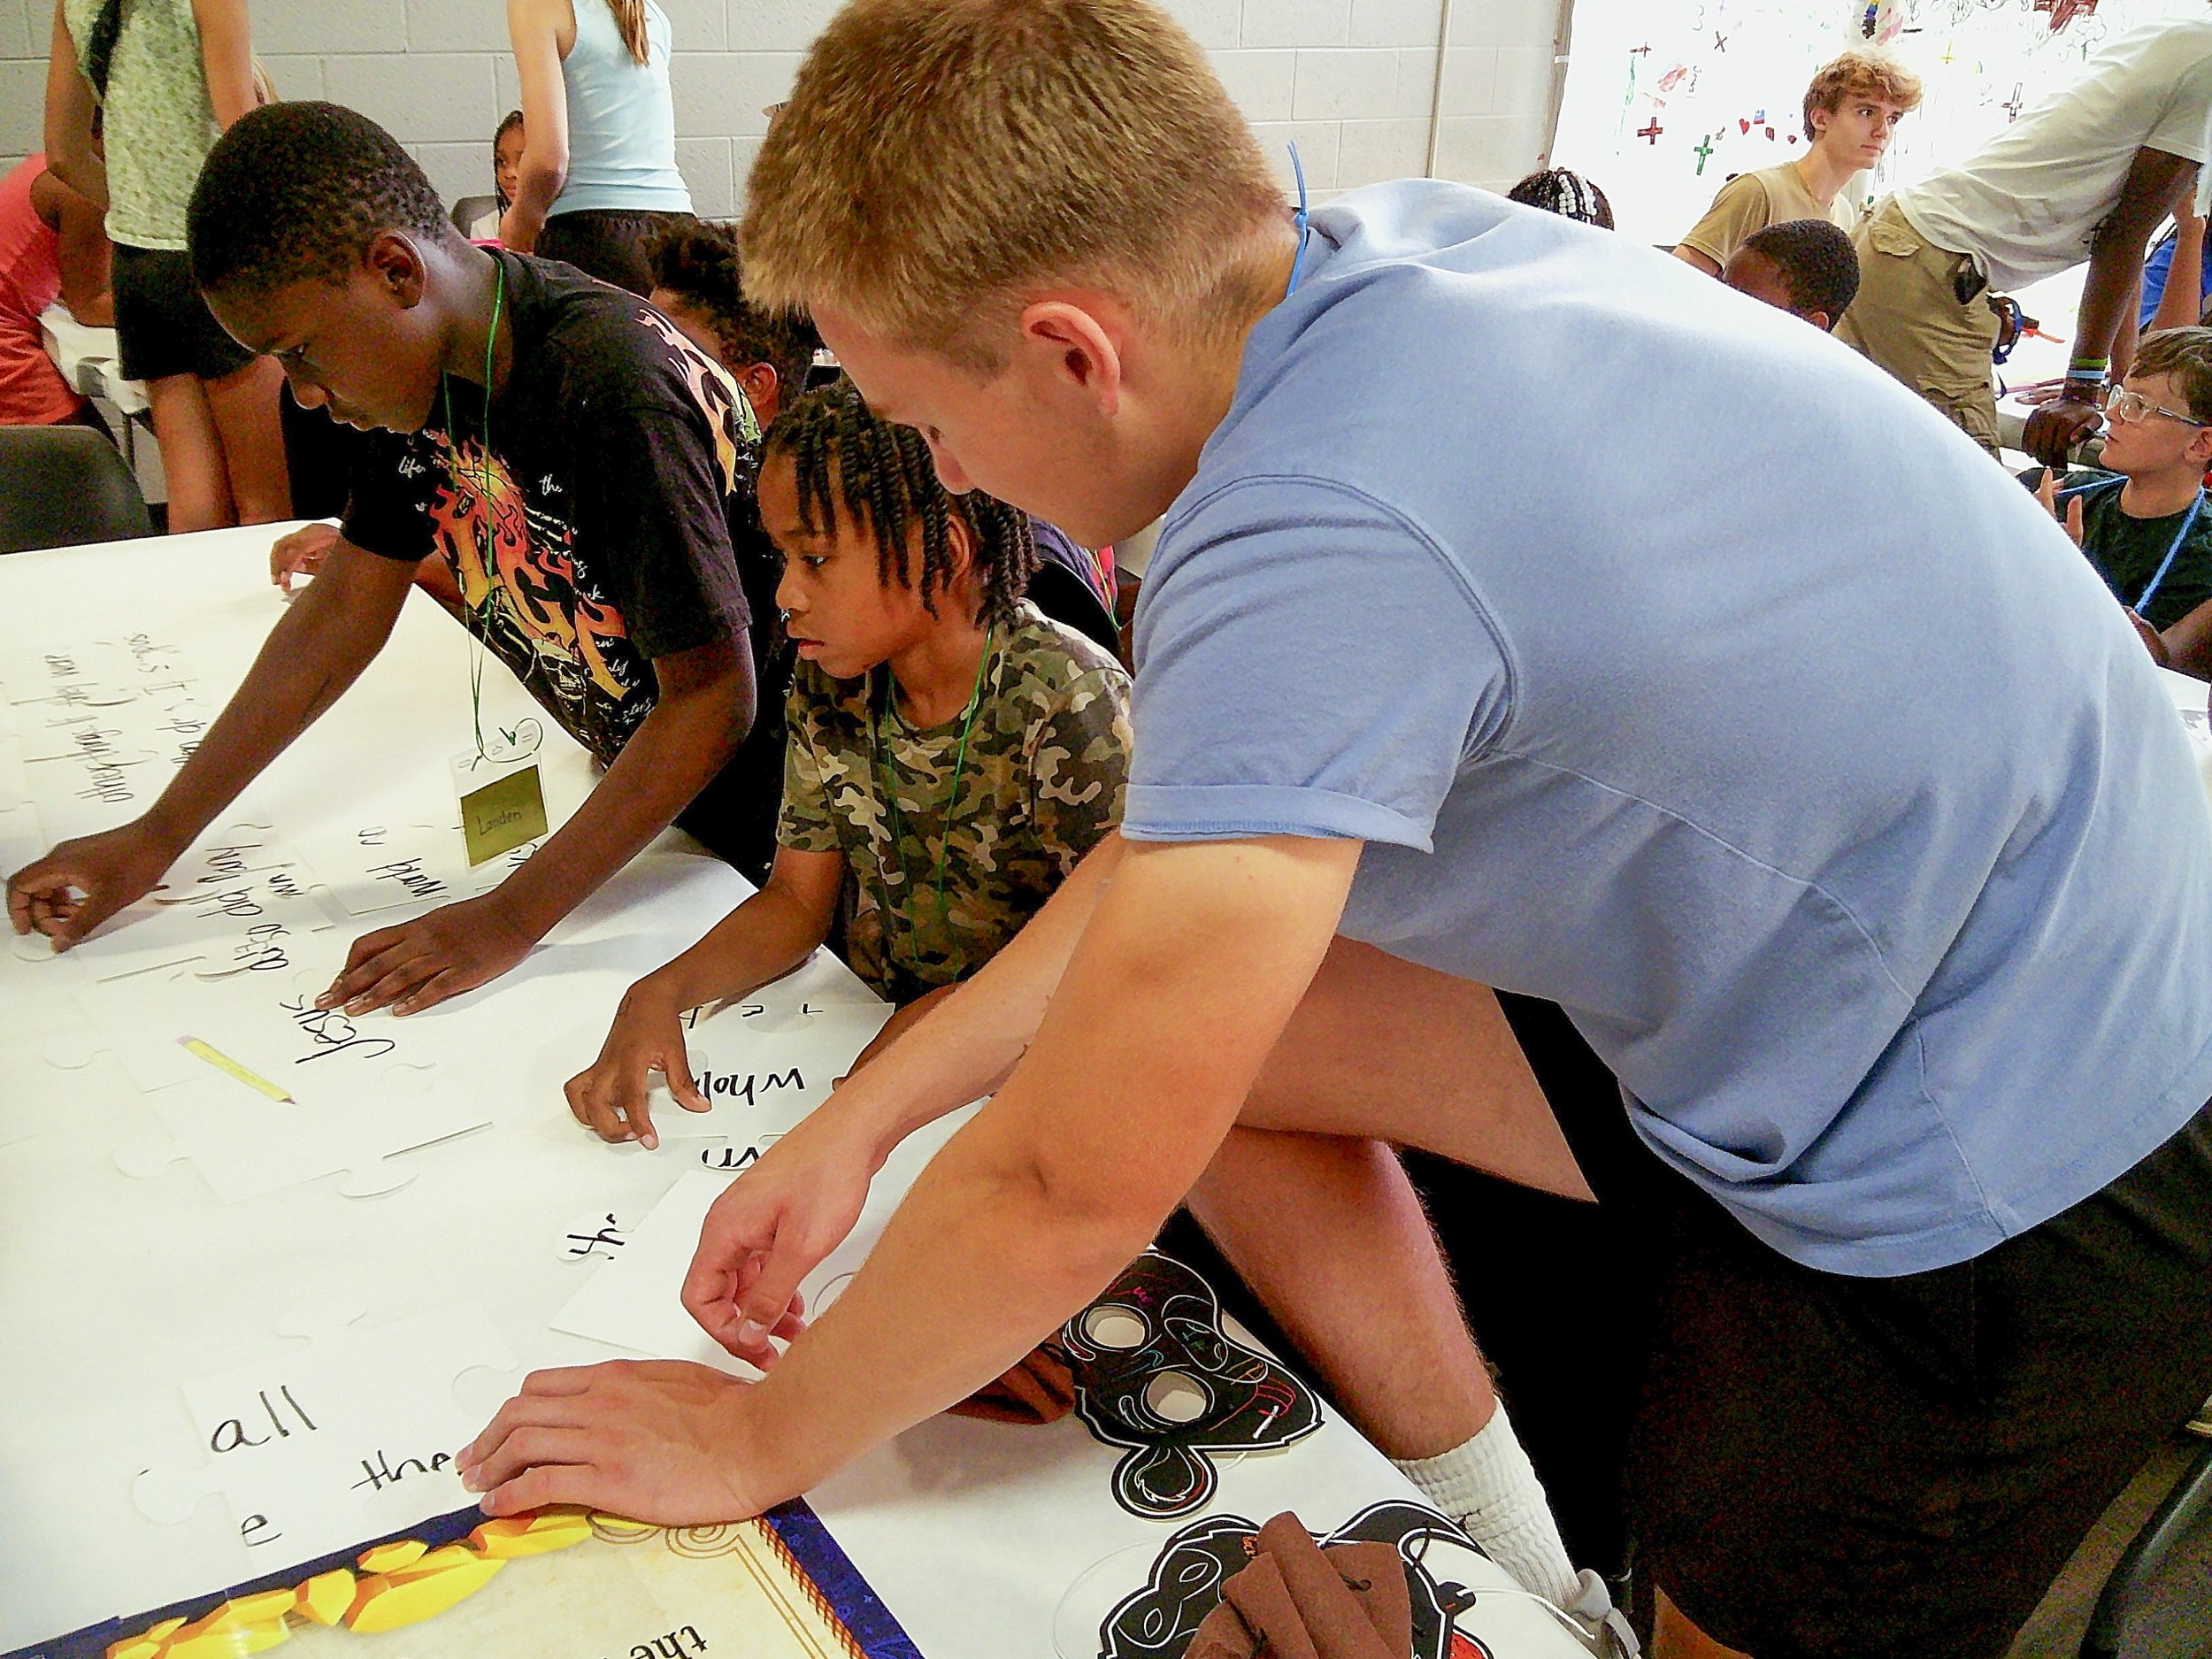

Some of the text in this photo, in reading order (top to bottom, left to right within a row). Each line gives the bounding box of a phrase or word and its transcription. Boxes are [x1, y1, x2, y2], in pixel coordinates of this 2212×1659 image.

[365, 856, 451, 899] world
[279, 994, 396, 1065] Jesus
[695, 1067, 806, 1107] whol
[211, 1385, 319, 1454] all
[629, 1625, 708, 1659] the
